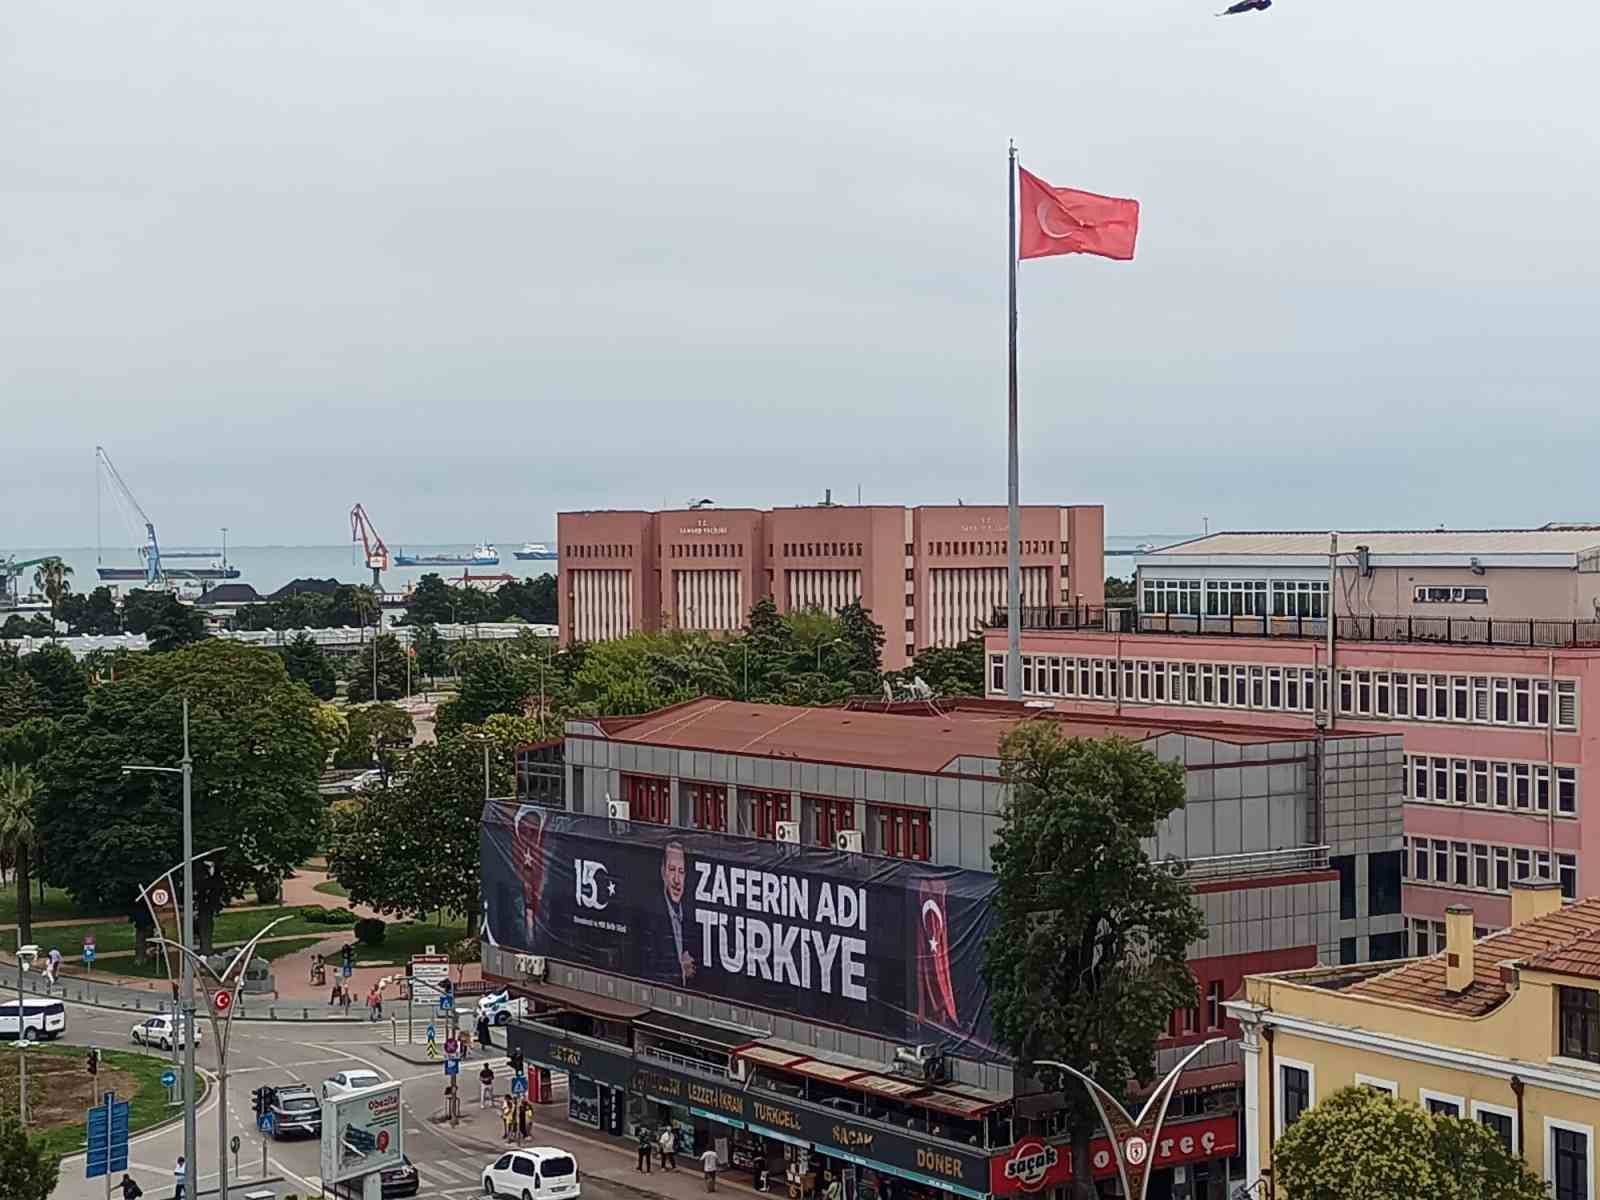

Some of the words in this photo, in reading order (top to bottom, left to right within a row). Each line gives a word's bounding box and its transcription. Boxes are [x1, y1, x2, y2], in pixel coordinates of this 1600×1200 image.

[574, 858, 600, 909] 15
[695, 861, 809, 920] ZAFERİN
[815, 881, 867, 931] ADI
[695, 908, 867, 1001] TÜRKİYE
[1006, 1146, 1057, 1178] saçak
